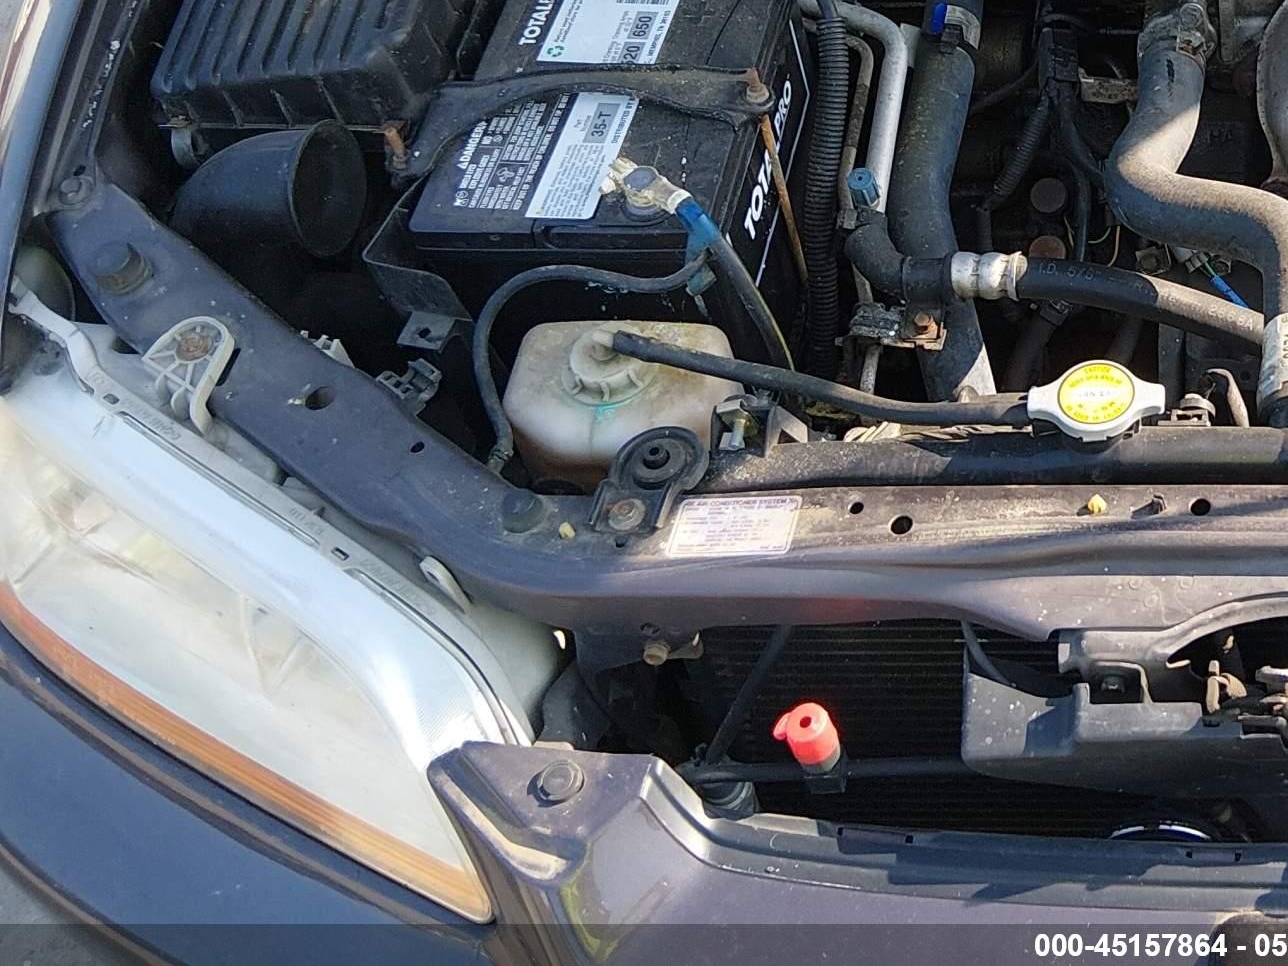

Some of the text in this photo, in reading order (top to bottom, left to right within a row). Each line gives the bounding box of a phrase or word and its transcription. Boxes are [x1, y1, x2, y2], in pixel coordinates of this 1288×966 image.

[631, 15, 652, 36] 650
[589, 111, 612, 137] 35-T
[744, 80, 791, 240] TOTAPRO
